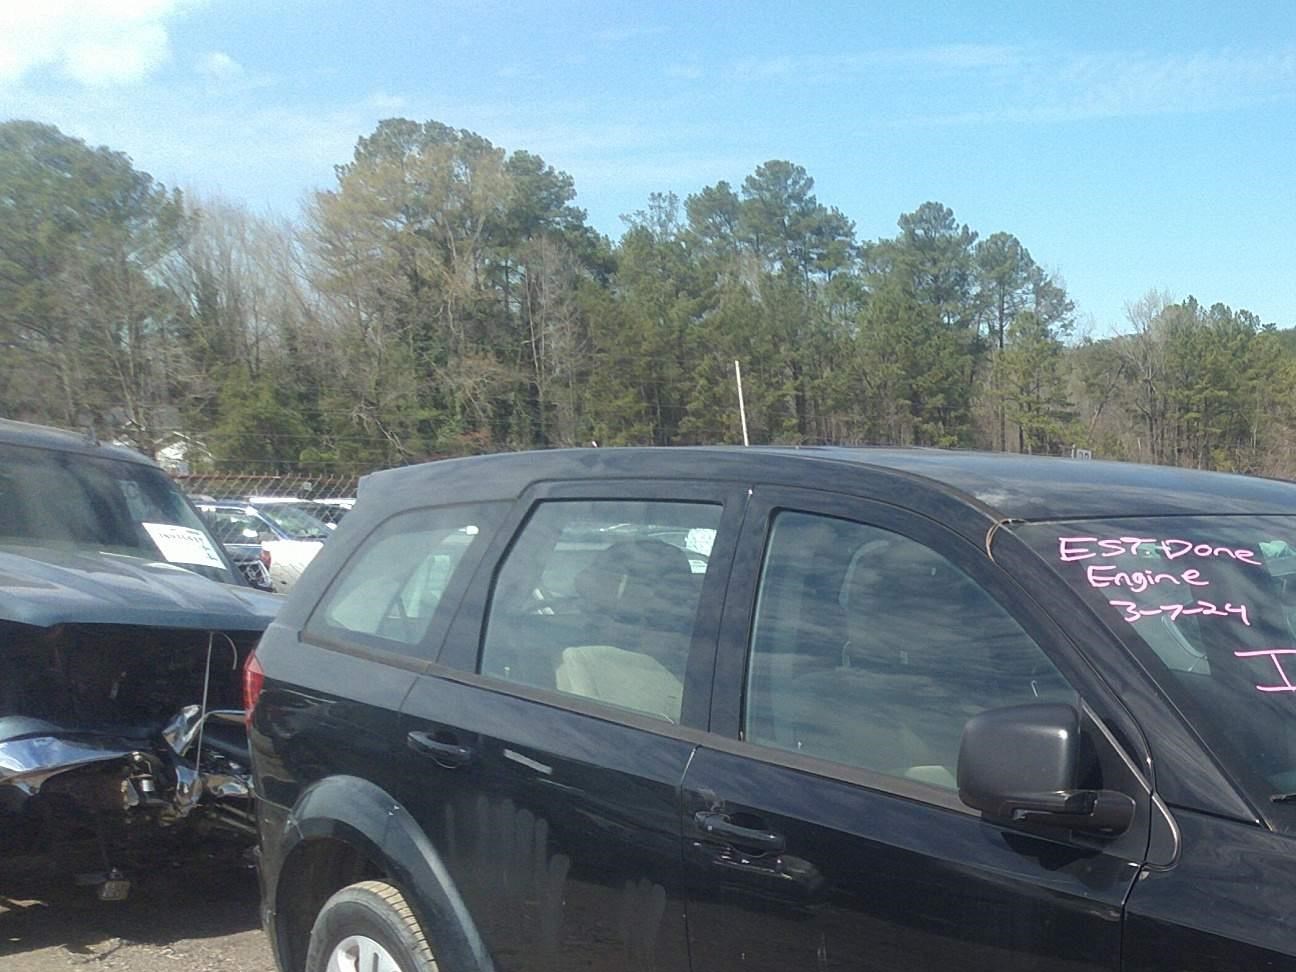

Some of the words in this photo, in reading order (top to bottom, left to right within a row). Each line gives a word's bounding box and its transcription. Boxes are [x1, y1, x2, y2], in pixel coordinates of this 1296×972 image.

[1157, 538, 1263, 566] Done
[1086, 564, 1210, 593] Engine
[1108, 600, 1250, 626] 3-7-24
